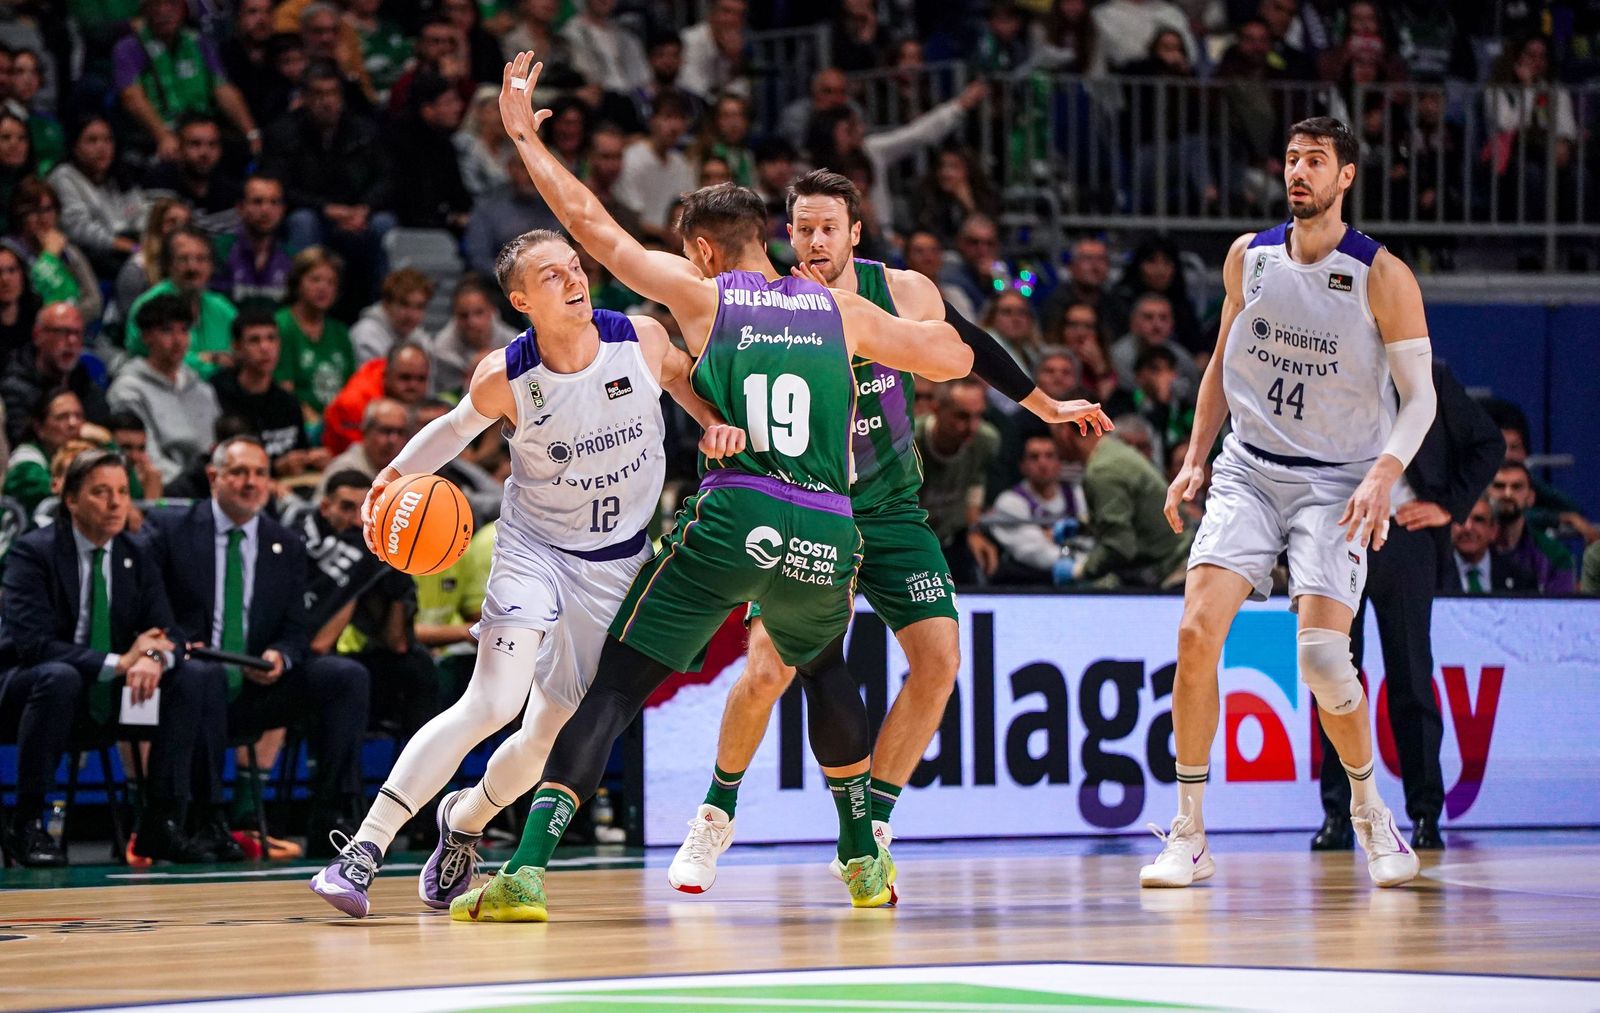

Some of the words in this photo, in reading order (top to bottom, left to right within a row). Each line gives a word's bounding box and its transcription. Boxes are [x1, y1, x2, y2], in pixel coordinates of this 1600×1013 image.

[1275, 322, 1340, 340] FUNDACIÓN
[1275, 329, 1338, 355] PROBITAS
[1247, 345, 1339, 377] JOVENTUT
[1267, 377, 1305, 421] 44
[573, 415, 642, 441] FUNDACIÓN
[743, 373, 811, 458] 19
[575, 422, 643, 458] PROBITAS
[552, 448, 647, 491] JOVENTUT
[387, 491, 424, 555] Wilson
[589, 496, 620, 533] 12
[789, 536, 838, 562] COSTA
[781, 564, 833, 586] MÁLAGA
[785, 552, 810, 570] DEL
[812, 560, 836, 574] SOL
[905, 570, 929, 584] sabor
[909, 587, 948, 603] laga
